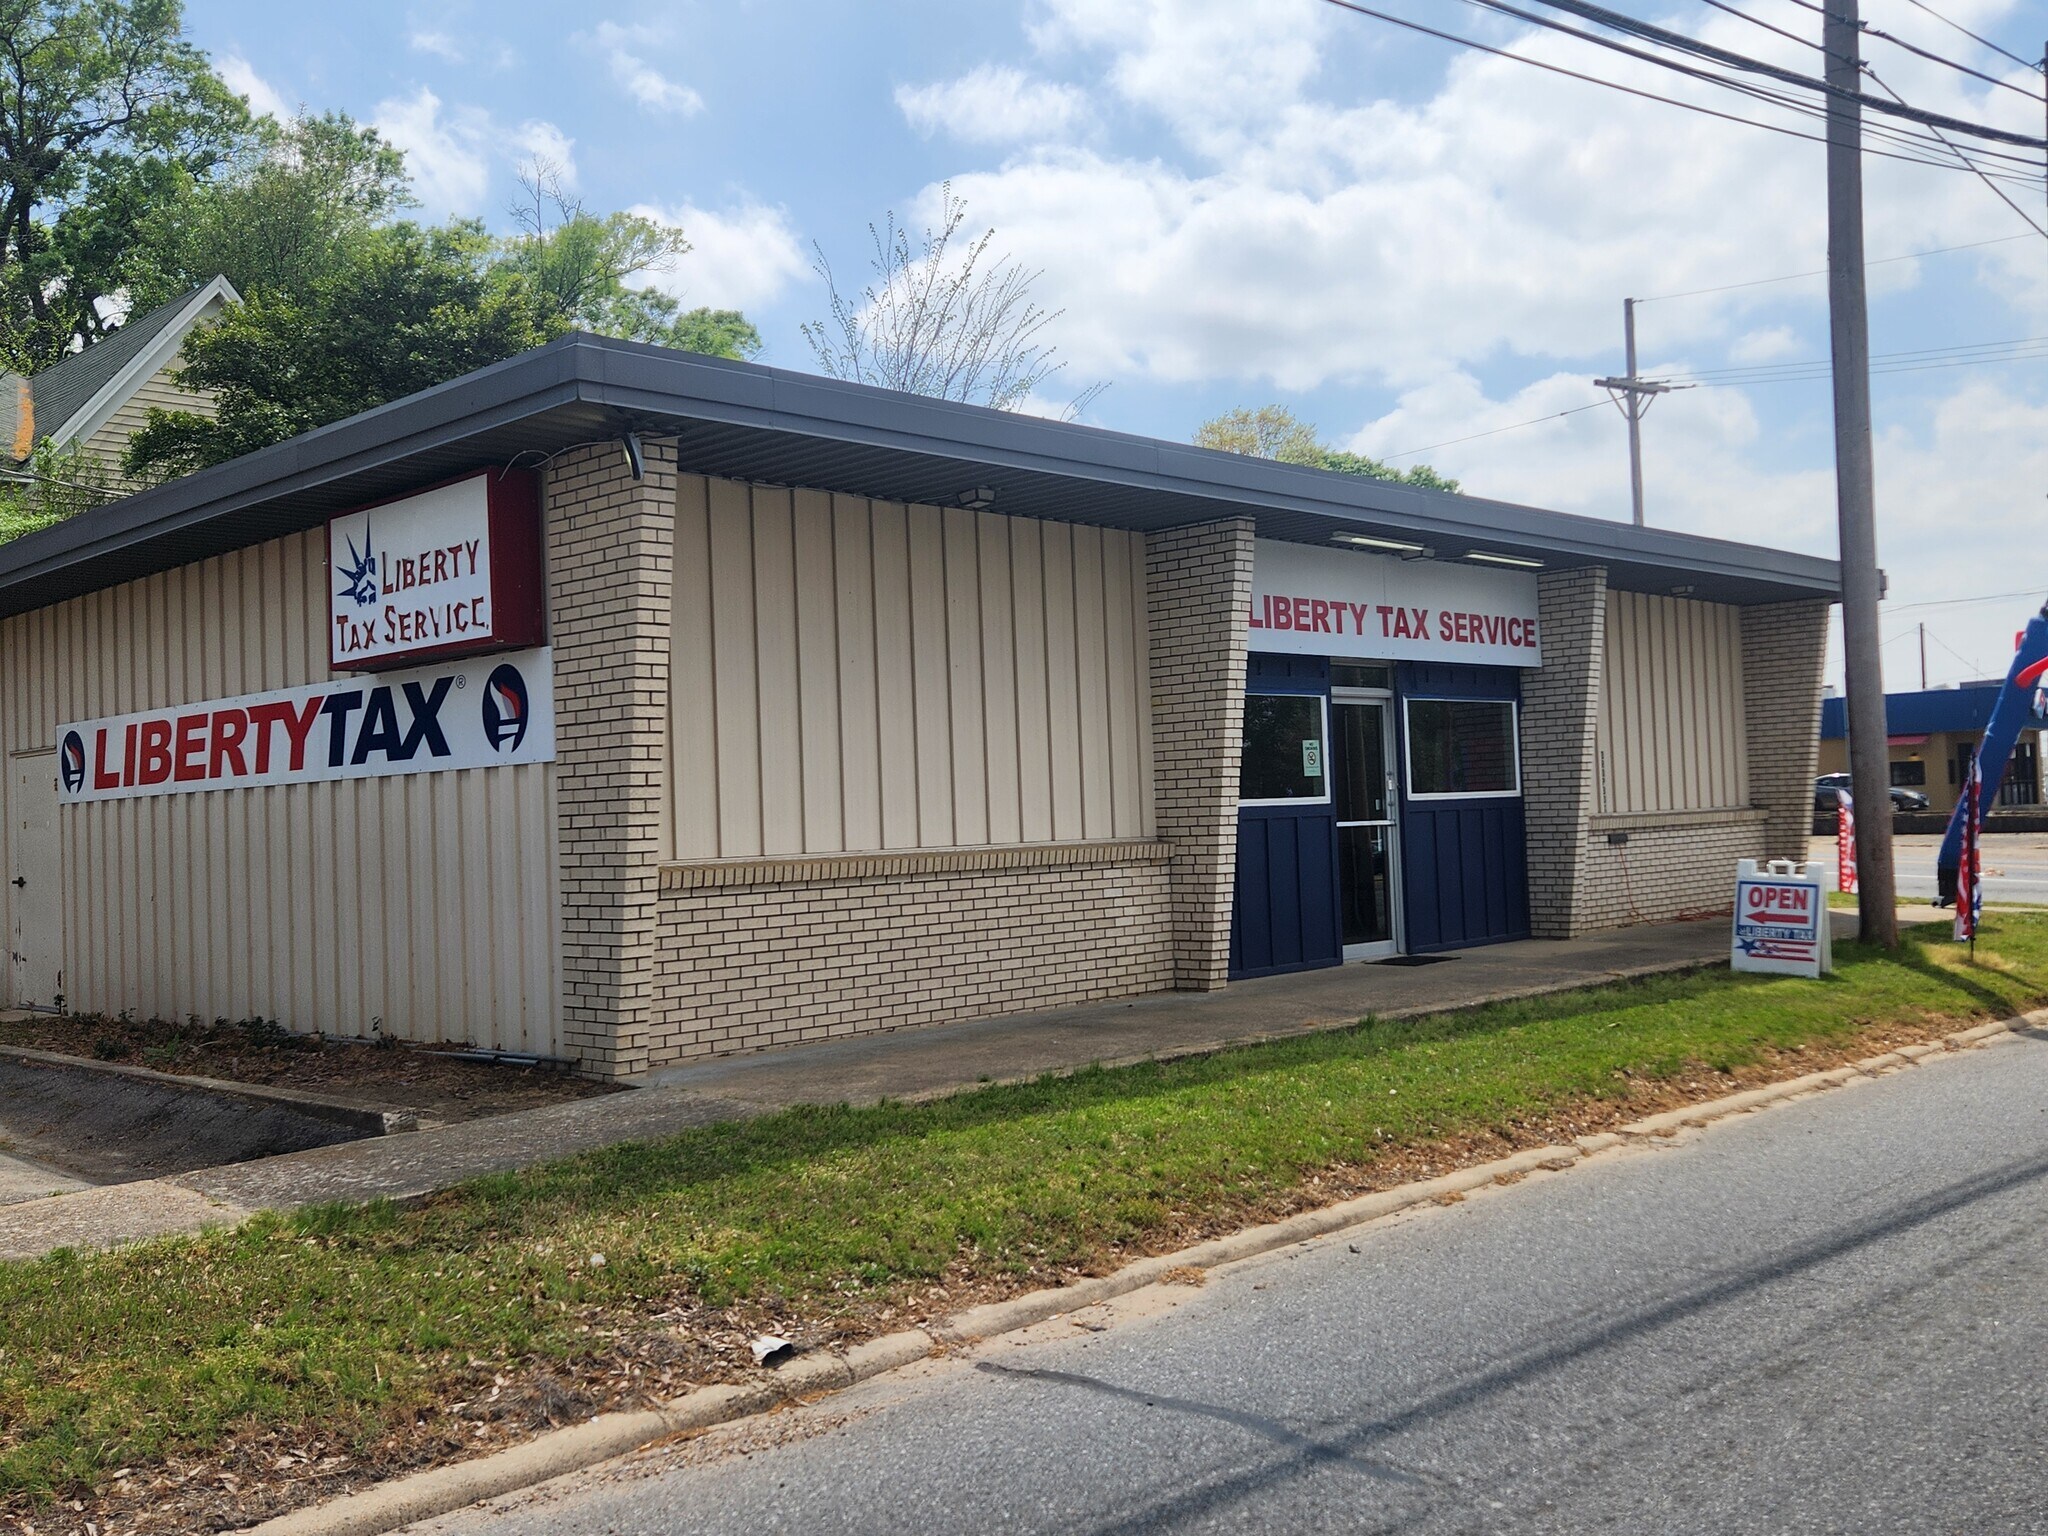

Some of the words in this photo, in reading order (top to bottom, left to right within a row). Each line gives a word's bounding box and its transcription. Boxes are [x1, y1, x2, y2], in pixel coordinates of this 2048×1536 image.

[382, 538, 480, 596] LIBERTY
[336, 615, 378, 653] TAX
[1248, 593, 1368, 636] LIBERTY
[1376, 606, 1431, 641] TAX
[1439, 610, 1538, 649] SERVICE
[1748, 886, 1808, 911] OPEN
[1745, 926, 1791, 939] LIBERTY
